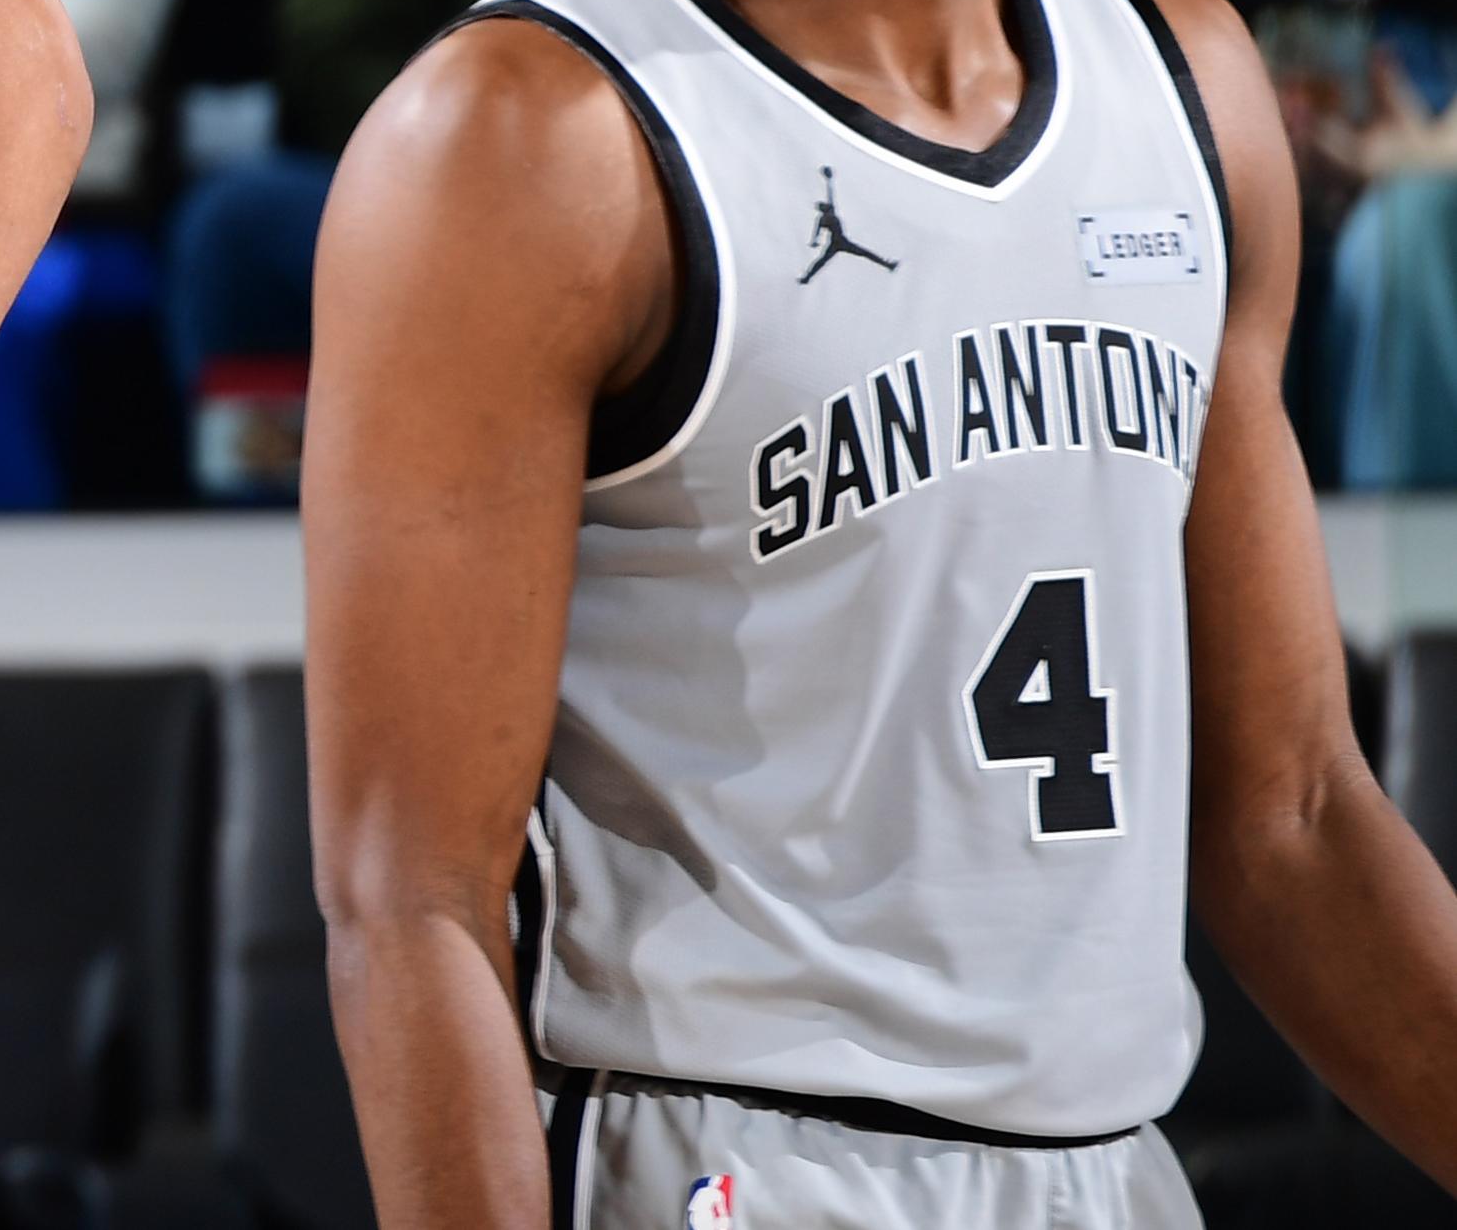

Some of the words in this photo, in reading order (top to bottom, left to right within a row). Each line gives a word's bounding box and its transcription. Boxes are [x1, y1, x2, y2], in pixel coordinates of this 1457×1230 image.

[1097, 231, 1182, 259] LEDGER
[750, 351, 939, 564] SAN
[952, 318, 1212, 490] ANTON
[963, 569, 1126, 842] 4
